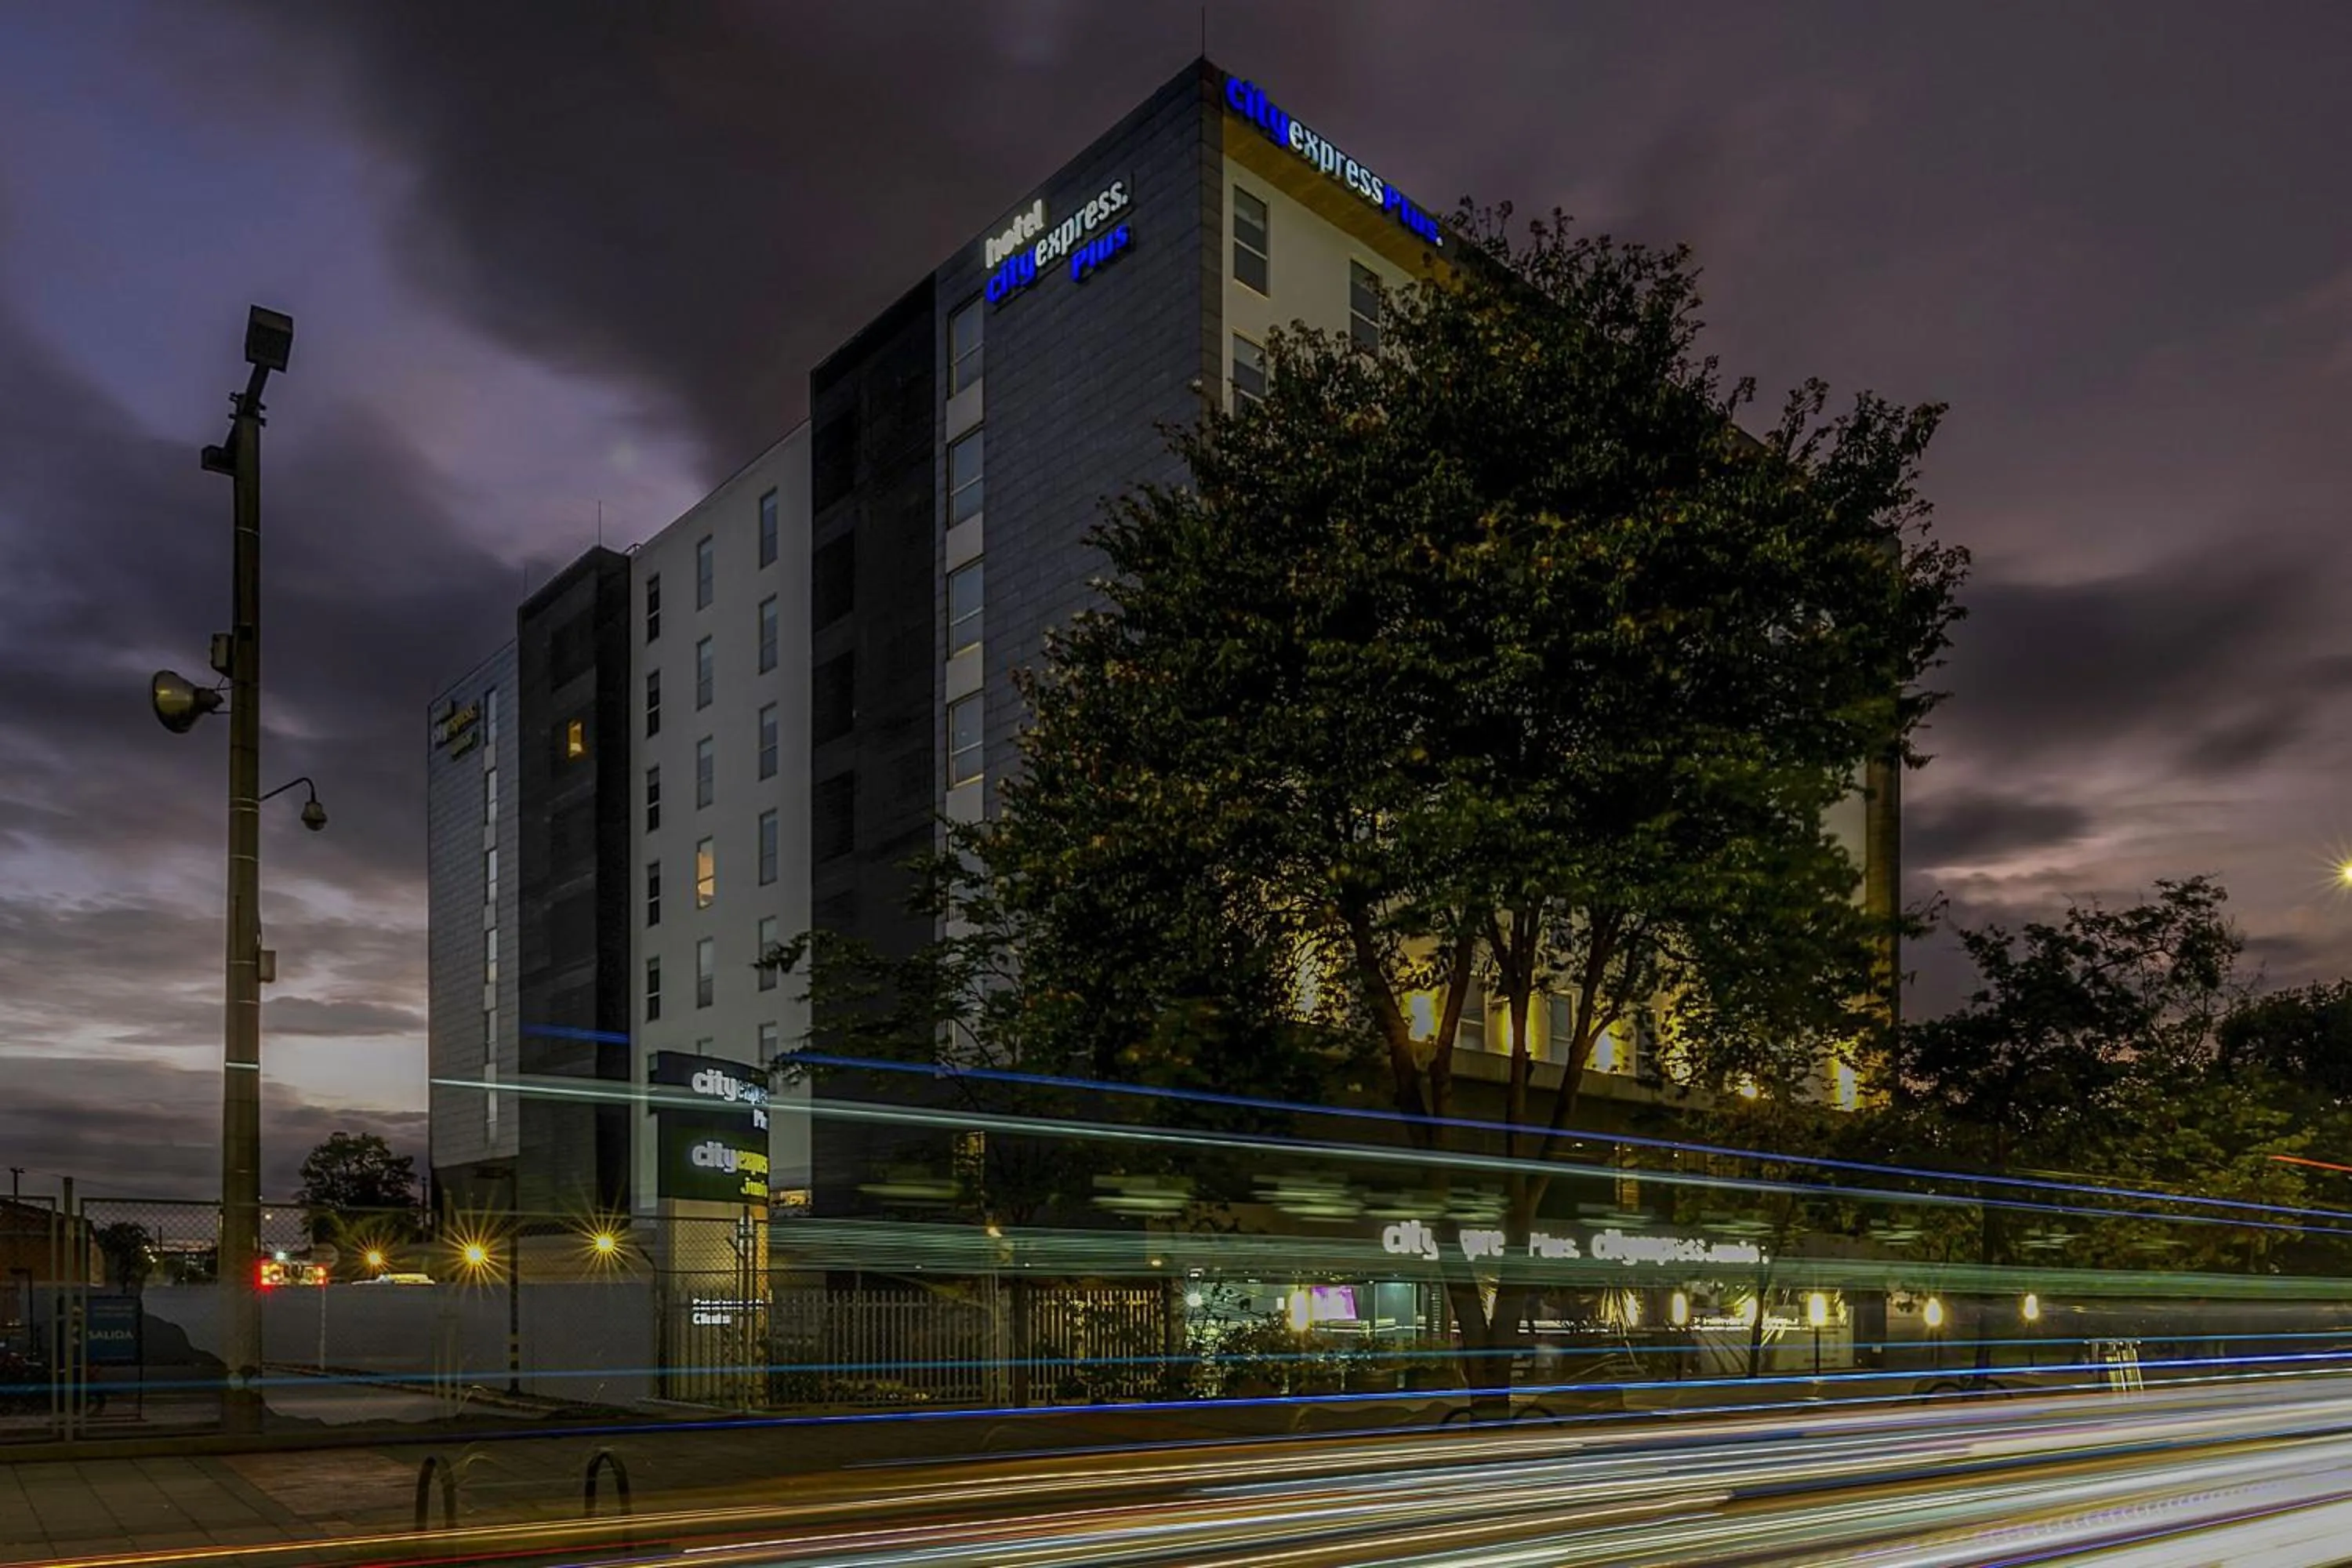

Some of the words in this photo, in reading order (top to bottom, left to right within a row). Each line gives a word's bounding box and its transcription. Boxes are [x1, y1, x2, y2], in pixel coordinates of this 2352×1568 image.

[985, 199, 1044, 269] hotel
[1070, 225, 1130, 283] Plus
[87, 1329, 134, 1341] SALIDA
